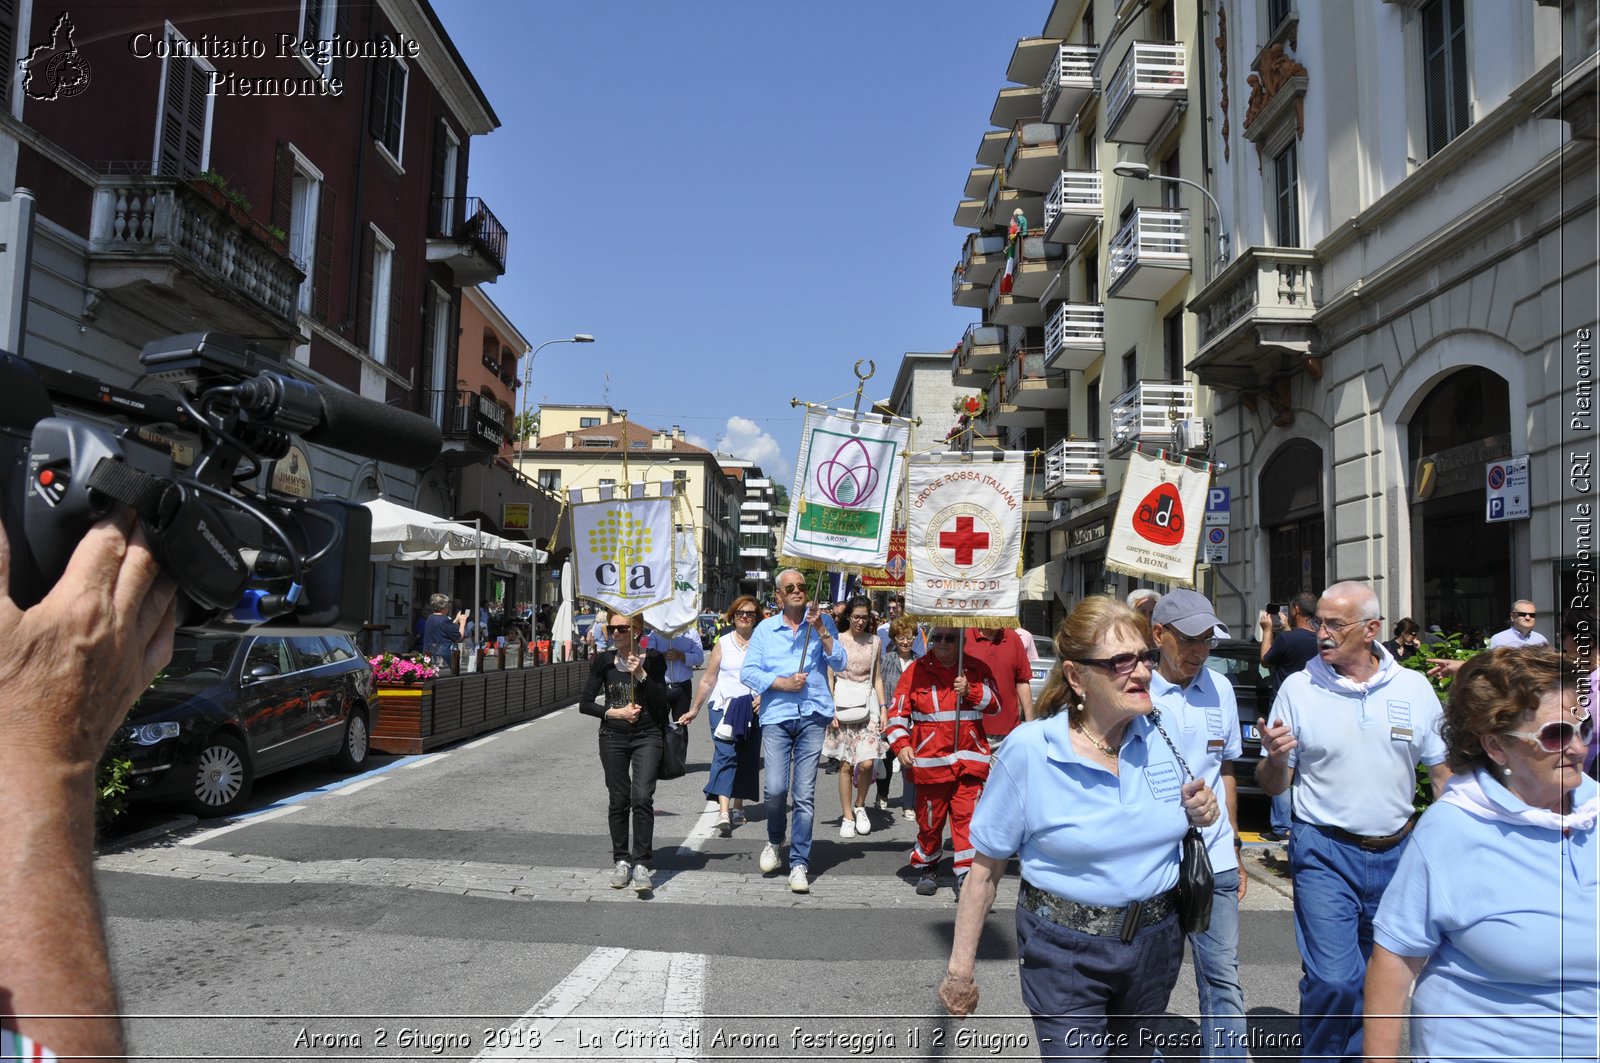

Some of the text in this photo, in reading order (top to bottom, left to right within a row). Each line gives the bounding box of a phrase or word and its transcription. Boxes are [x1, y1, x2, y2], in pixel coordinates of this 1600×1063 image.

[279, 472, 306, 489] JIMMY'S
[914, 471, 1017, 511] CROCE ROSSA ITALIANA
[1209, 489, 1226, 510] P
[1492, 500, 1501, 516] P
[197, 519, 239, 571] Panasonic
[825, 535, 849, 544] ARONA
[1126, 545, 1182, 564] GRUPPO COMUNALE
[1136, 556, 1169, 570] ARONA
[926, 579, 1000, 591] COMITATO DI
[935, 598, 991, 609] ARONA
